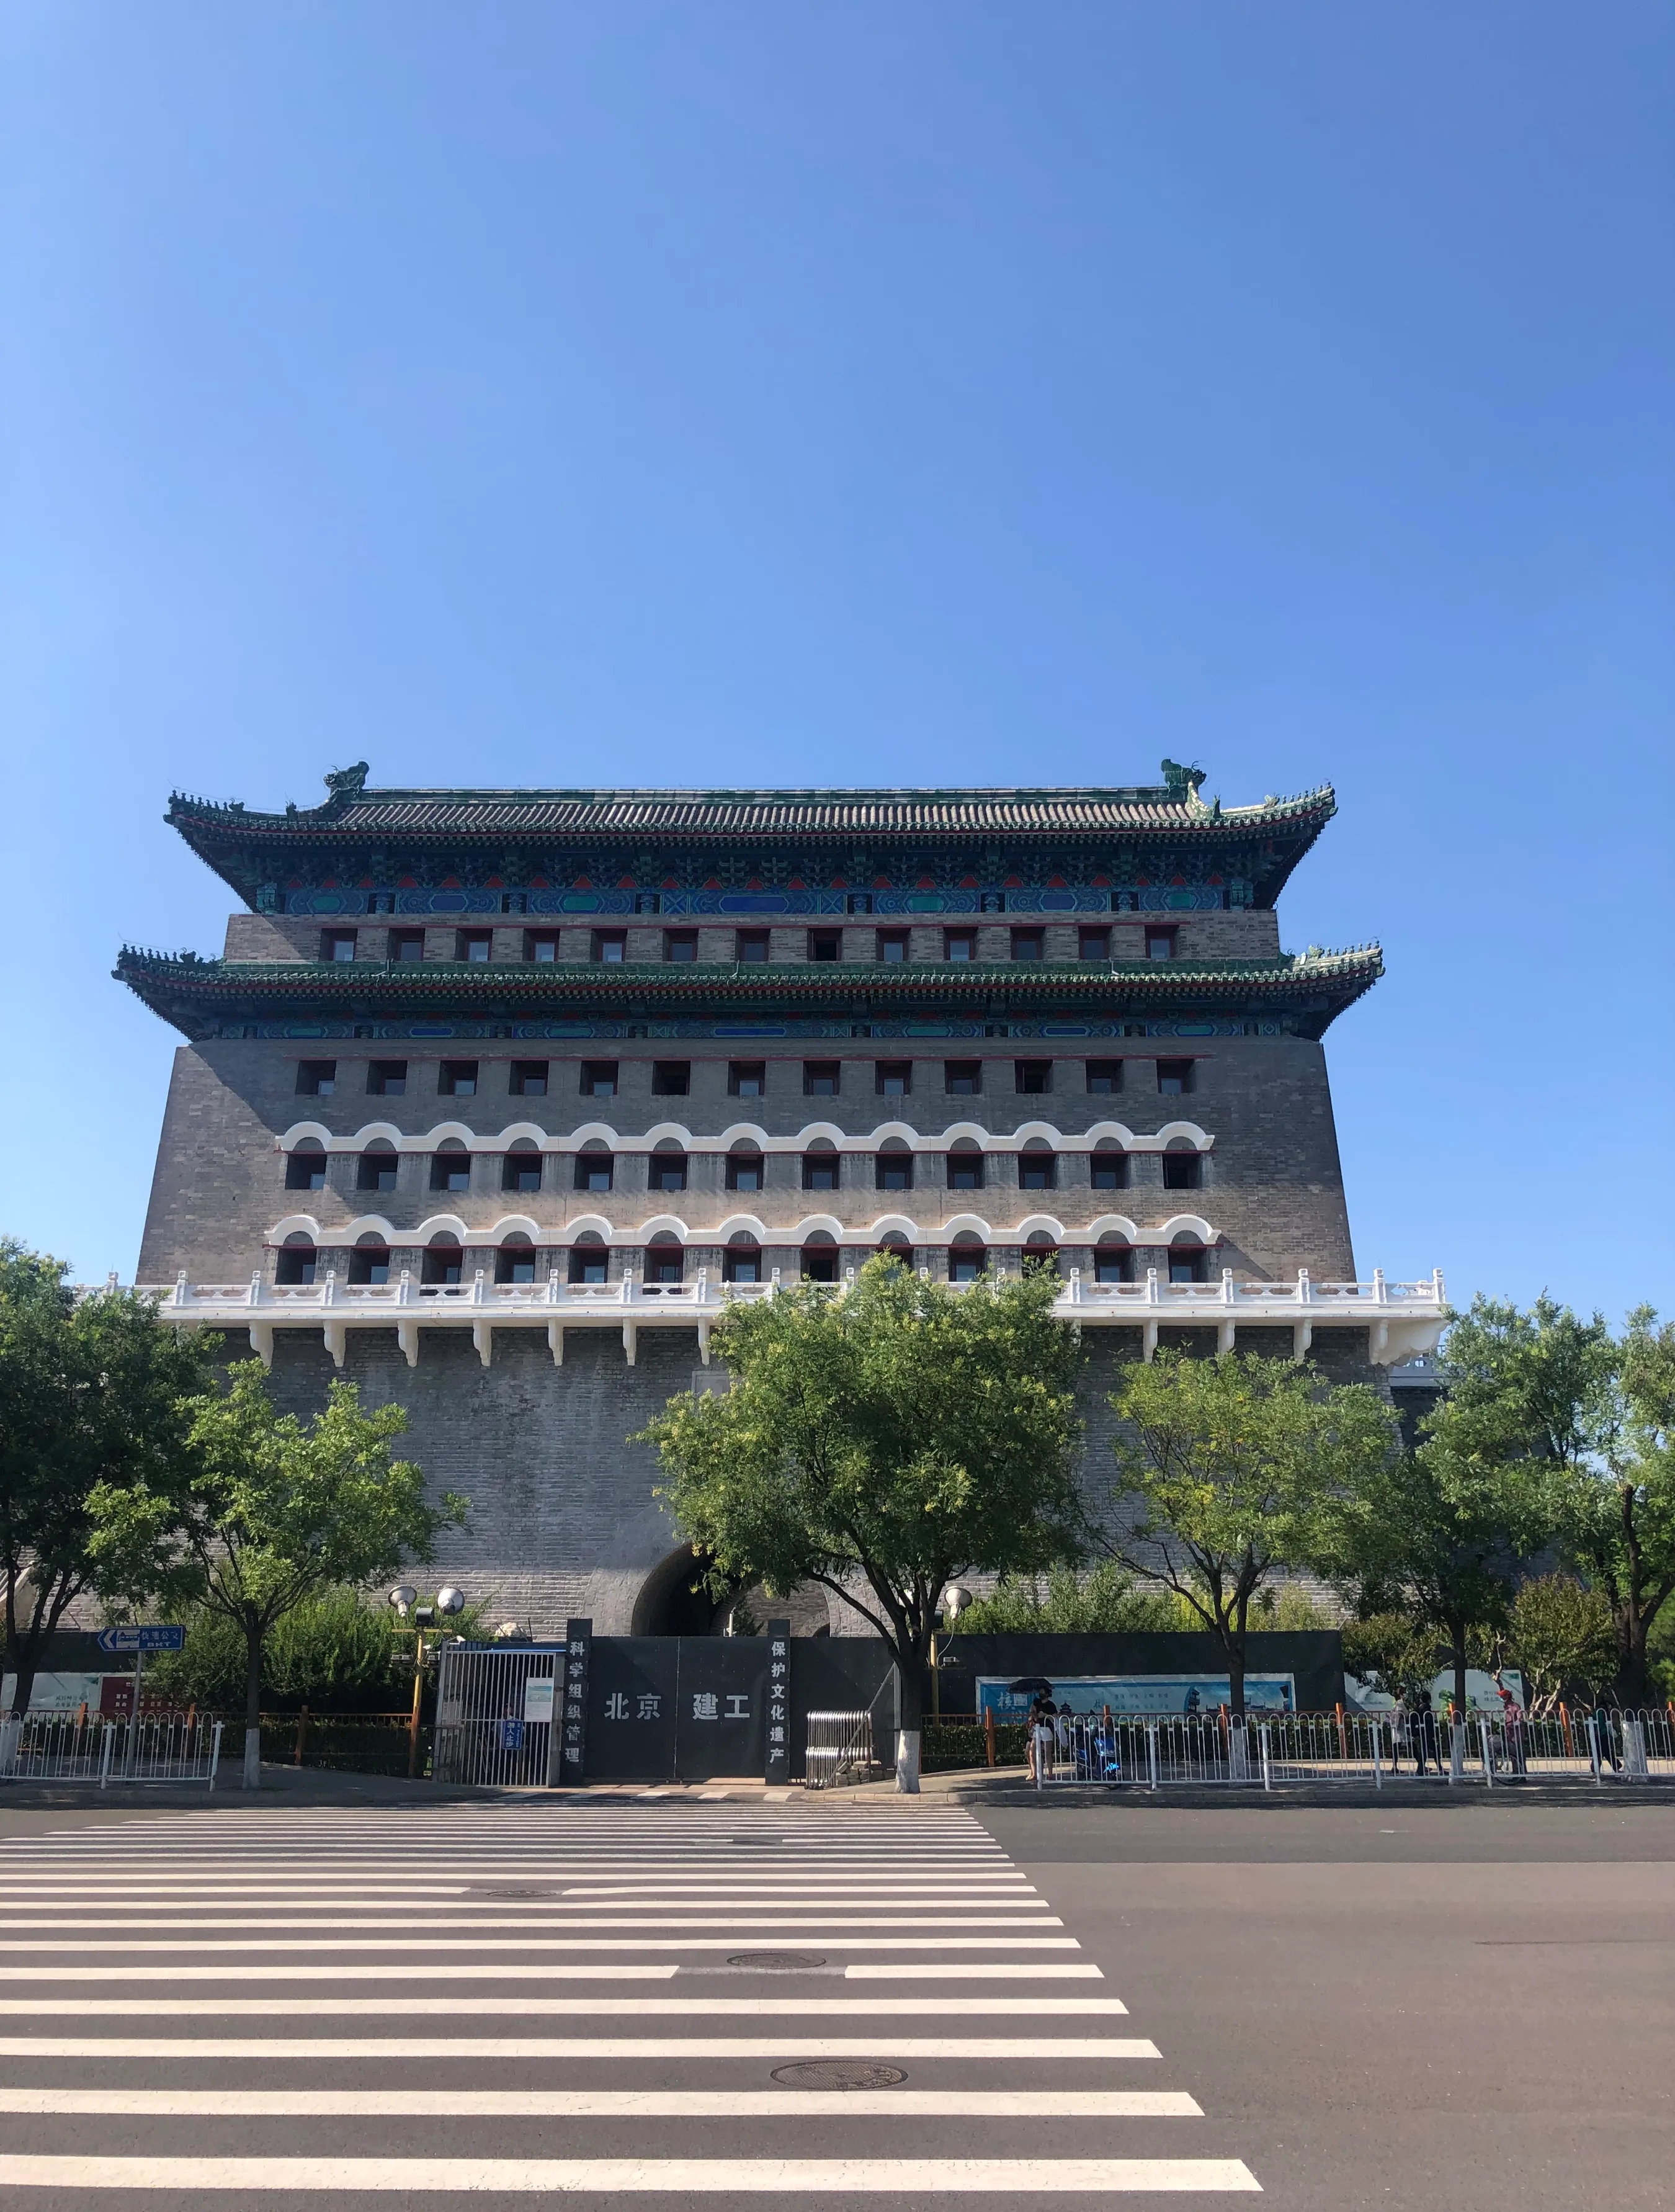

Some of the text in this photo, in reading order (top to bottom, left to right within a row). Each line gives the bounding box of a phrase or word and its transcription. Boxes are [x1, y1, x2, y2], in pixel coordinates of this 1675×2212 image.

[565, 1641, 584, 1762] 科学组织管理
[604, 1692, 750, 1720] 北京 建工
[769, 1641, 786, 1763] 保护文化遗产
